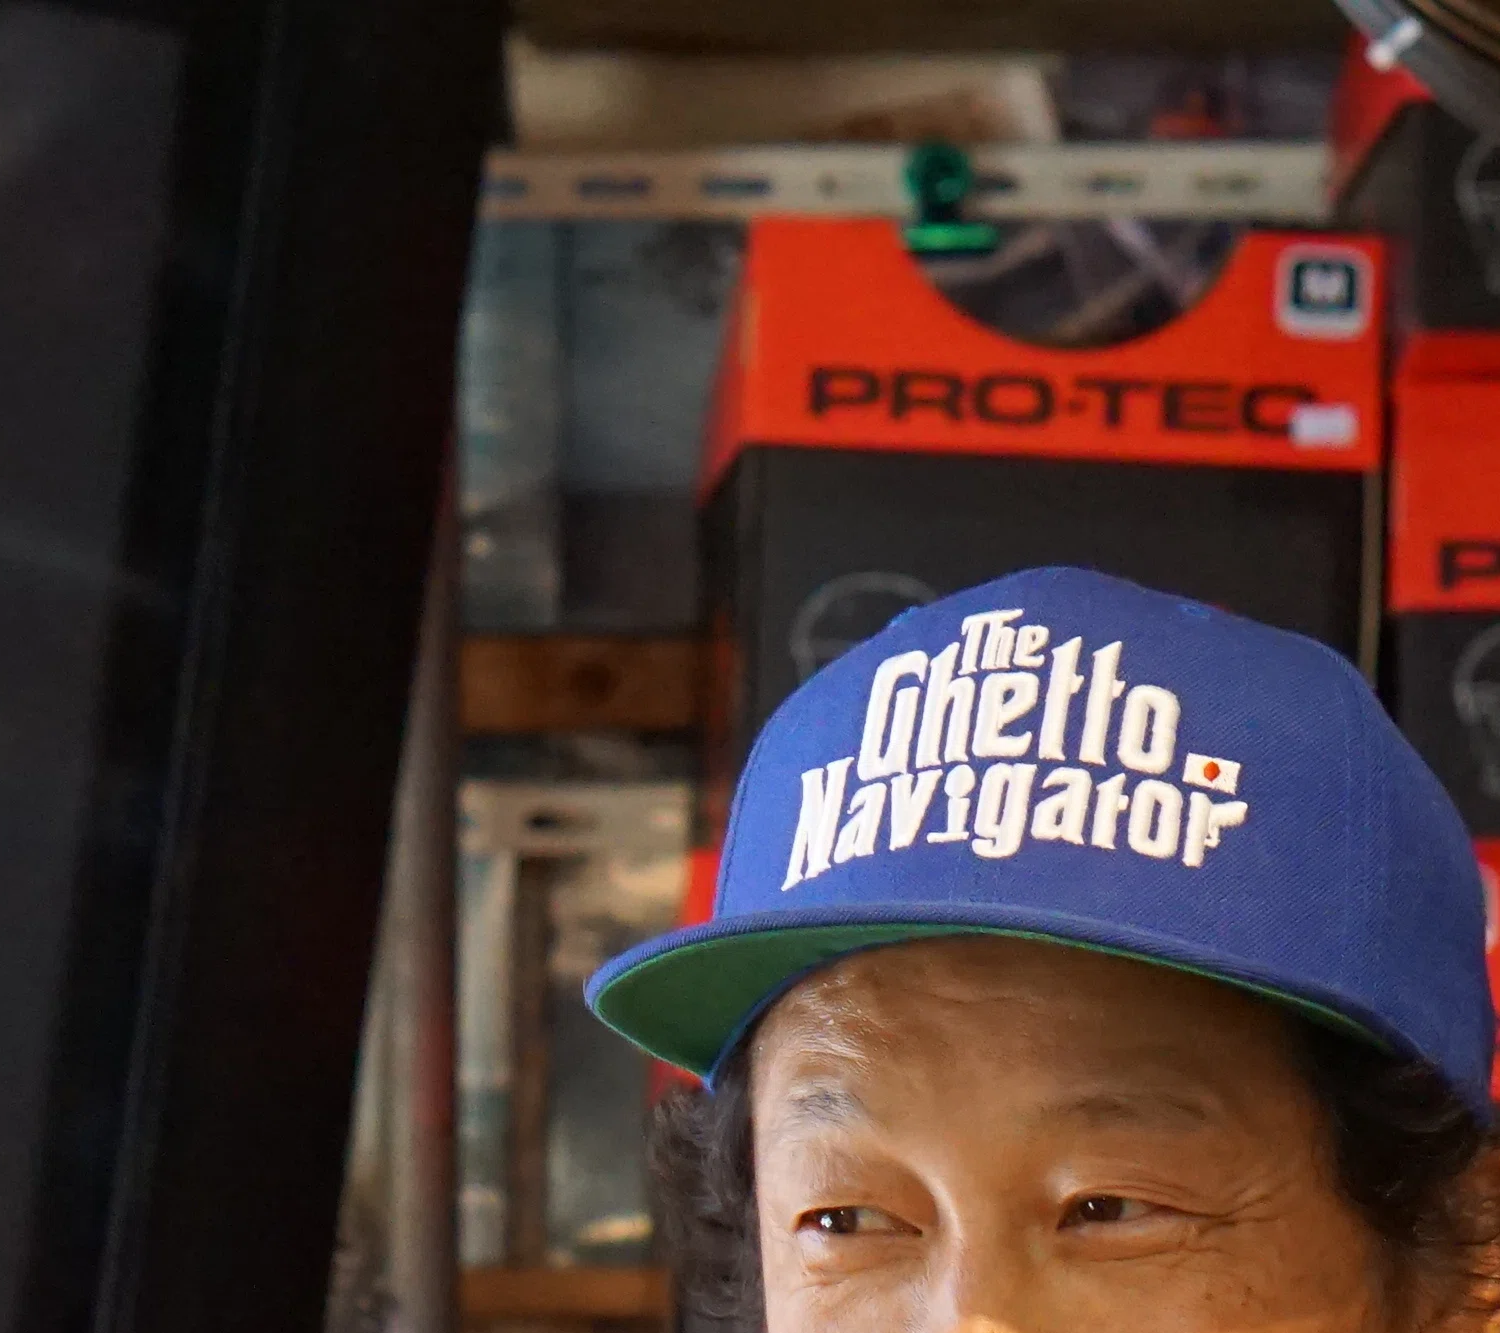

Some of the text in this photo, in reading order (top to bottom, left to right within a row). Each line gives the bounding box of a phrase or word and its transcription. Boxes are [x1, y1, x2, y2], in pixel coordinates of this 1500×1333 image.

[857, 638, 1181, 782] Ghetto
[961, 608, 1050, 675] The
[781, 755, 1248, 892] Navigator
